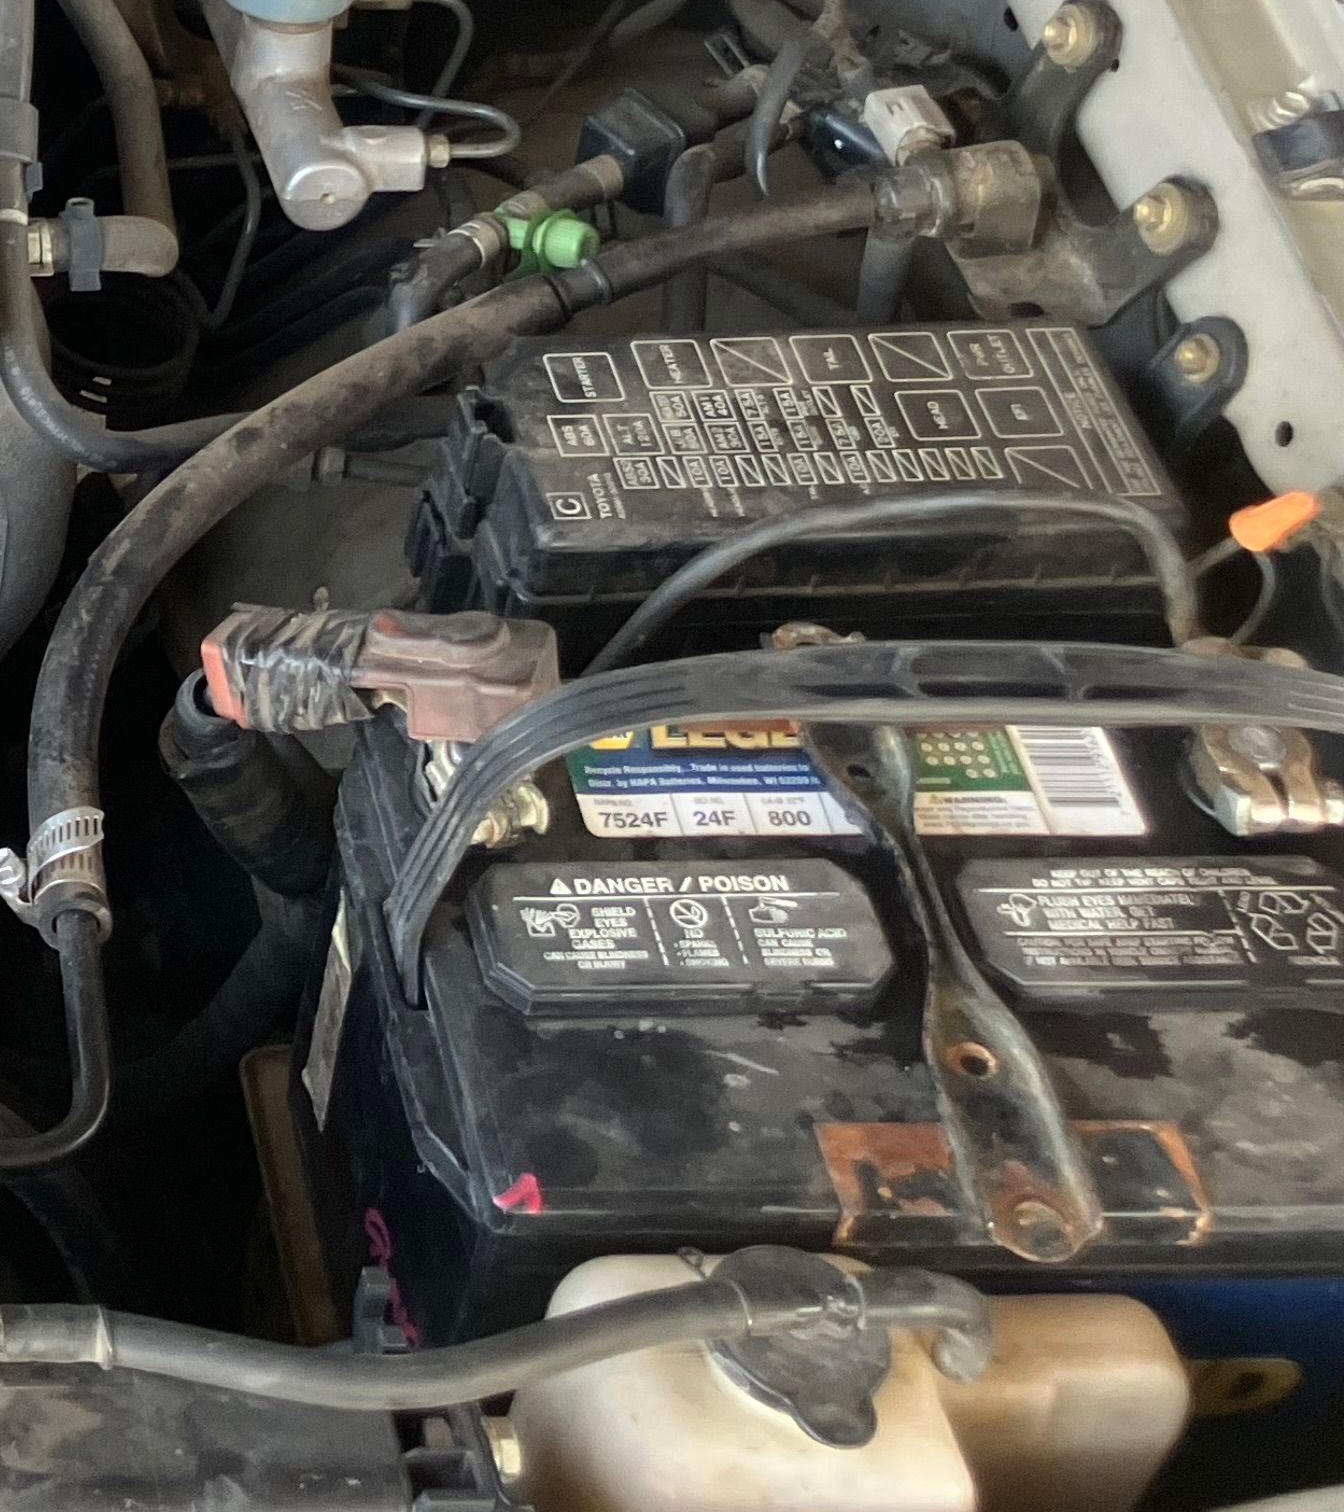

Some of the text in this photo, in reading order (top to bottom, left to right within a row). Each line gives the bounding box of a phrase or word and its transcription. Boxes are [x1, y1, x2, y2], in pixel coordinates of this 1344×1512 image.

[659, 344, 683, 384] HEATER
[571, 357, 597, 398] STARTER
[713, 394, 729, 416] 40A
[926, 400, 948, 430] HEAD
[561, 425, 578, 446] ABS
[616, 424, 634, 445] ALT
[690, 461, 705, 482] 10A
[717, 461, 732, 482] 10A
[793, 459, 809, 480] 10A
[847, 457, 863, 478] 10A
[555, 498, 581, 515] C
[587, 473, 612, 519] TOYOTA
[598, 809, 812, 829] 7524F 24F 800
[574, 874, 790, 895] DANGER / POISON
[1037, 895, 1081, 906] FLUSH
[1081, 894, 1115, 906] EYES
[591, 906, 636, 917] SHIELD
[568, 927, 637, 939] EXPLOSIVE
[594, 917, 628, 928] EYES
[684, 928, 704, 938] NO
[753, 927, 848, 938] SULFURIC ACID
[1047, 919, 1105, 930] MEDICAL
[571, 939, 615, 950] GASES
